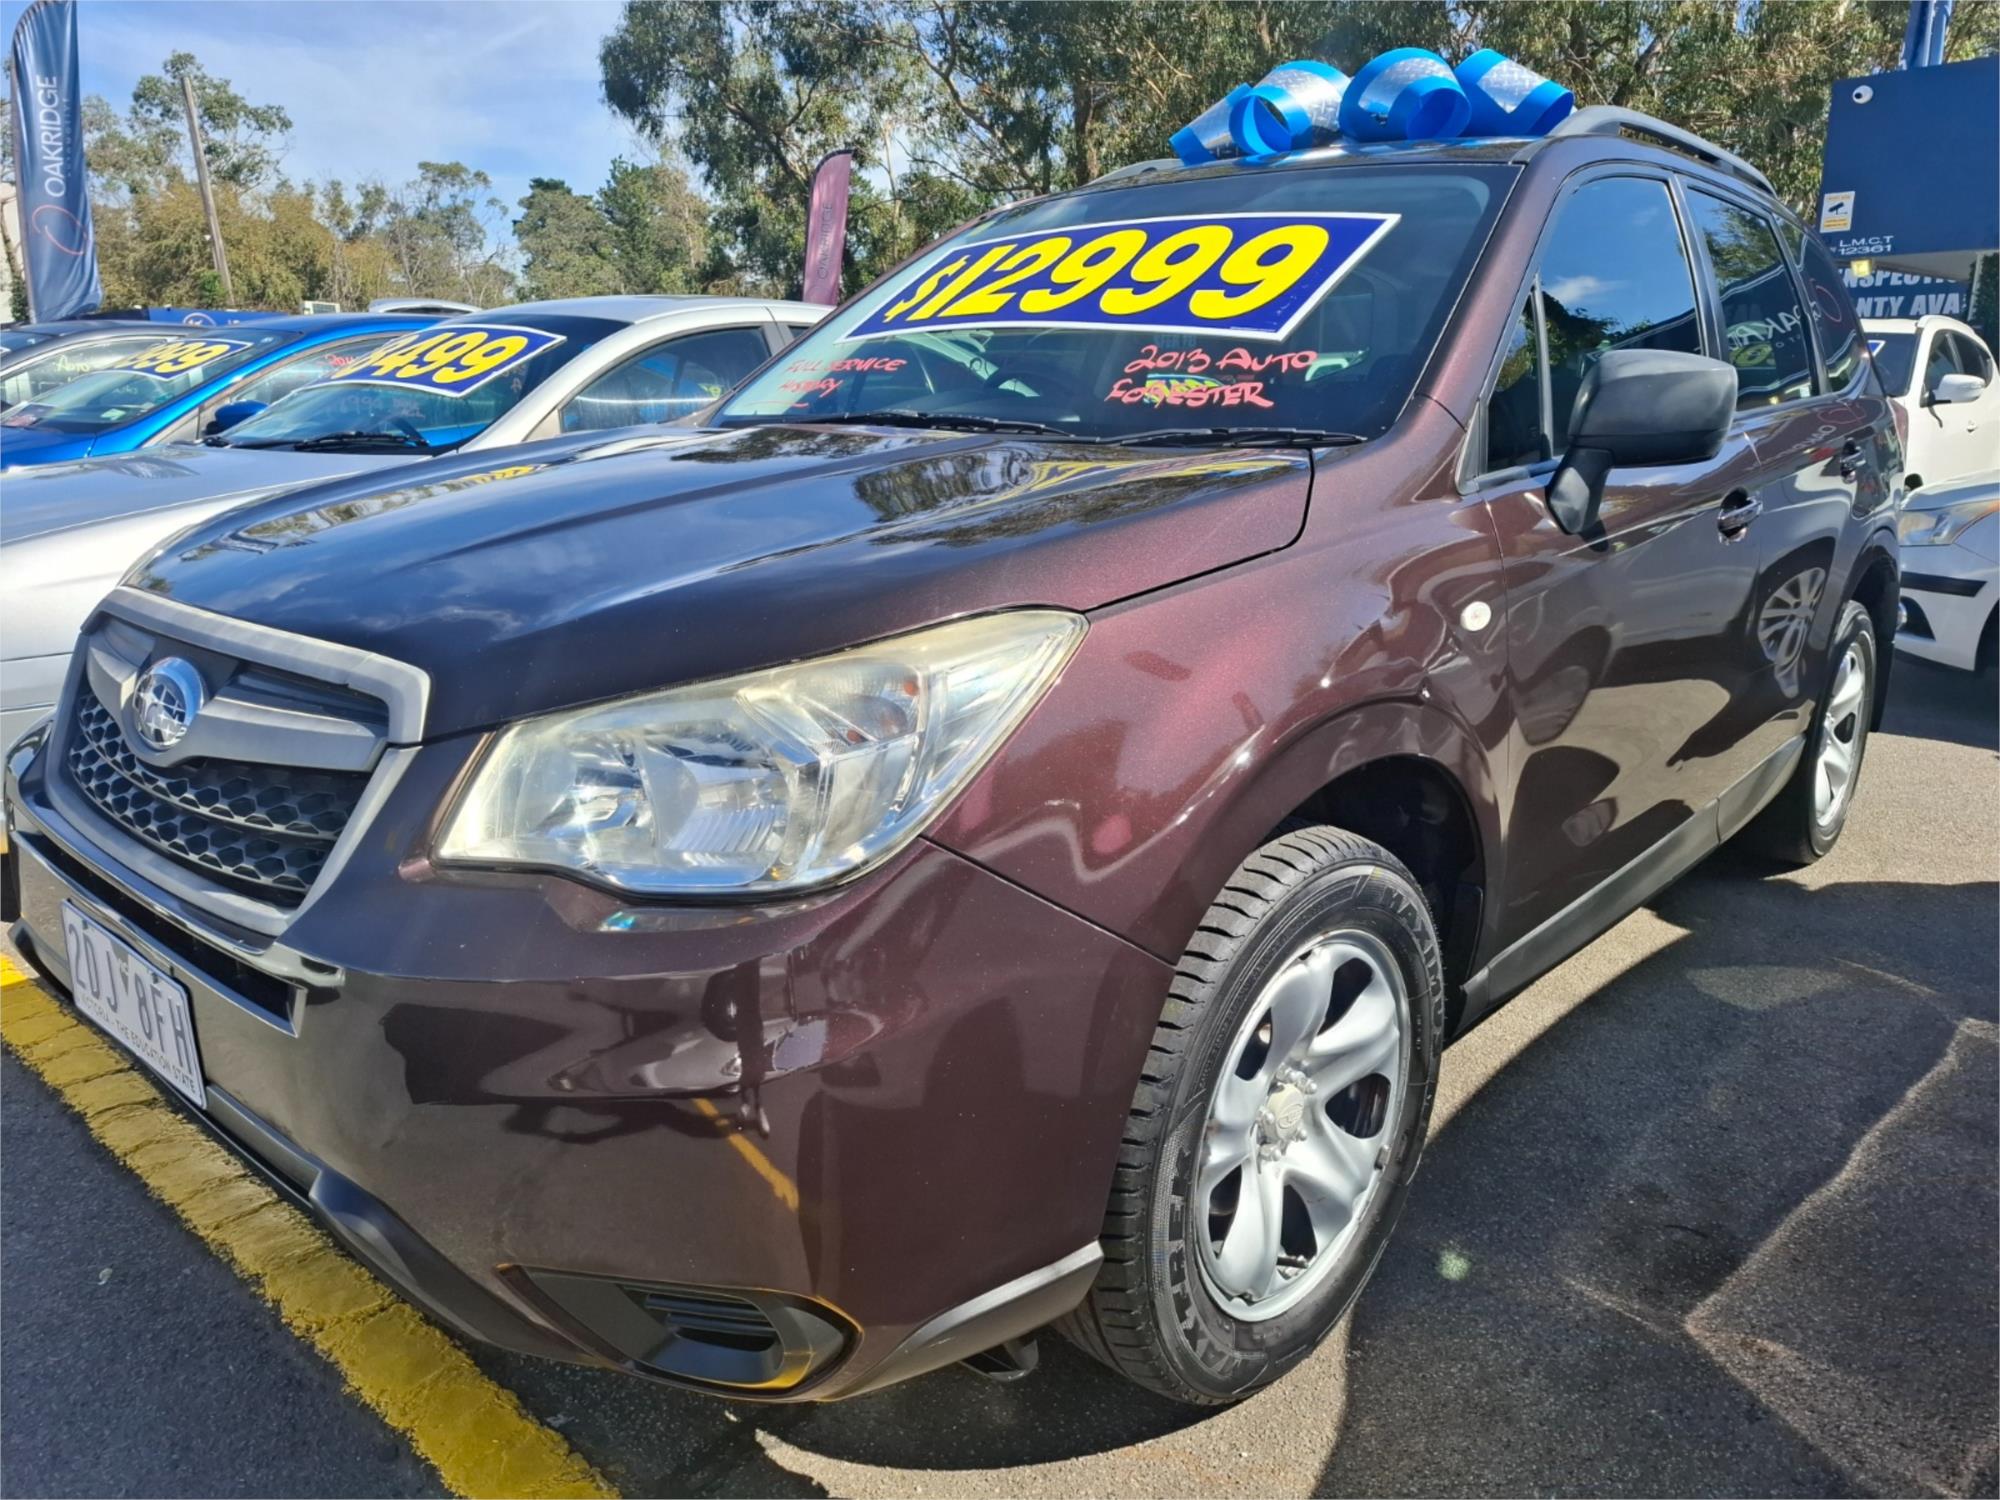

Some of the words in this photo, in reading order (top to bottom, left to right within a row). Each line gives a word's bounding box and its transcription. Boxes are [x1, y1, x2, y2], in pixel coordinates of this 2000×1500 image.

[36, 74, 66, 197] OAKRIDGE
[883, 224, 1330, 322] $12999
[1910, 293, 1967, 316] AVA
[1124, 344, 1211, 374] 2013
[1215, 347, 1318, 373] AUTO
[1104, 378, 1274, 408] FORESTER
